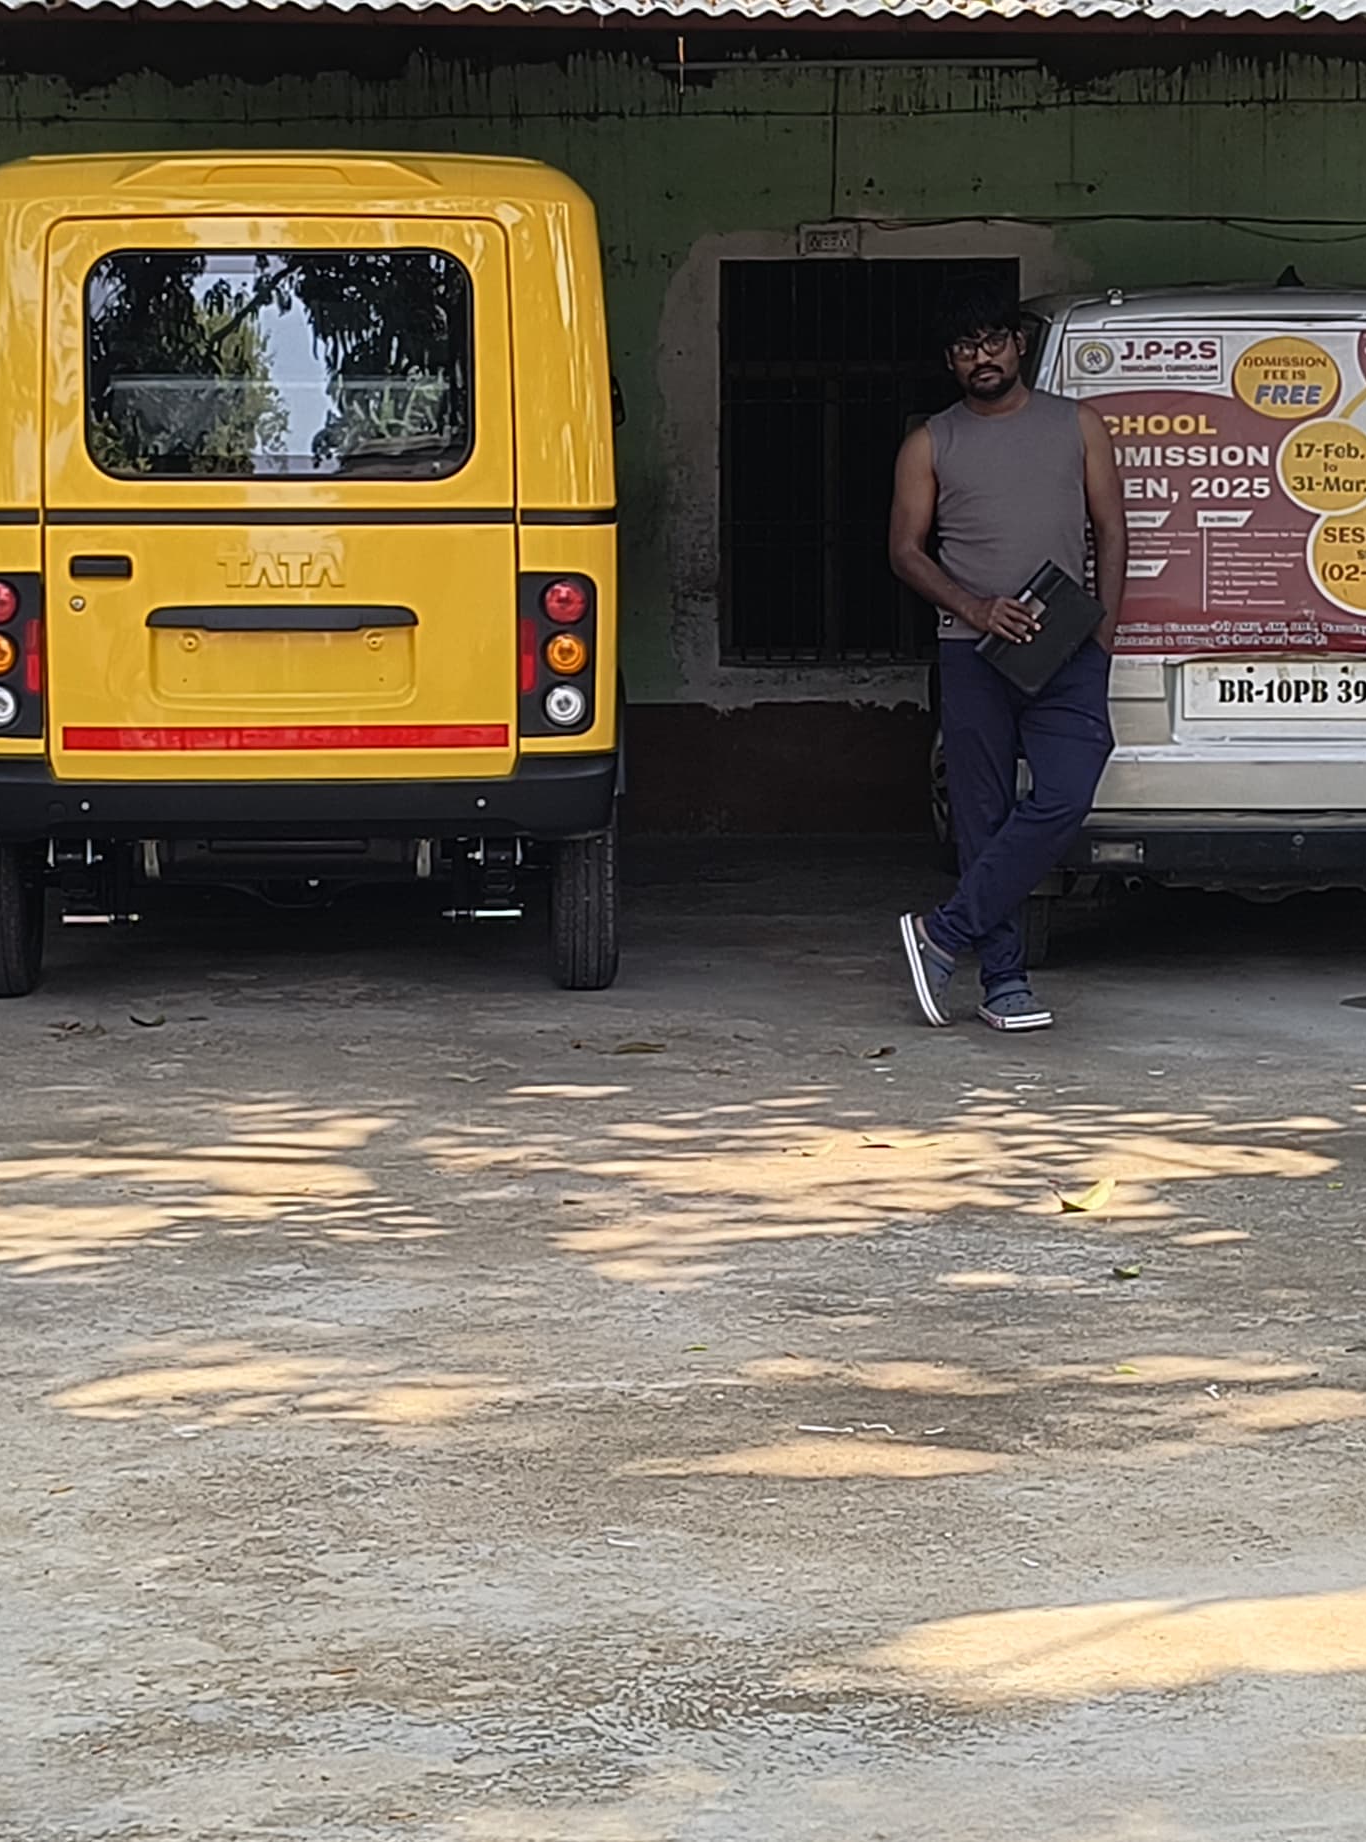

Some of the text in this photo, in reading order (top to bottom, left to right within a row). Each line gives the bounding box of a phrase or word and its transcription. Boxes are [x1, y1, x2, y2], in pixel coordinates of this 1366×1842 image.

[1120, 340, 1217, 361] J.P-P.S
[1243, 356, 1328, 369] ADMISSION
[1291, 369, 1306, 381] IS
[1254, 385, 1323, 405] FREE
[1102, 415, 1217, 435] CHOOL
[1295, 442, 1365, 460] 17-Feb.
[1124, 478, 1272, 503] EN, 2025
[218, 551, 346, 588] TATA
[1218, 679, 1329, 703] BR-10PB
